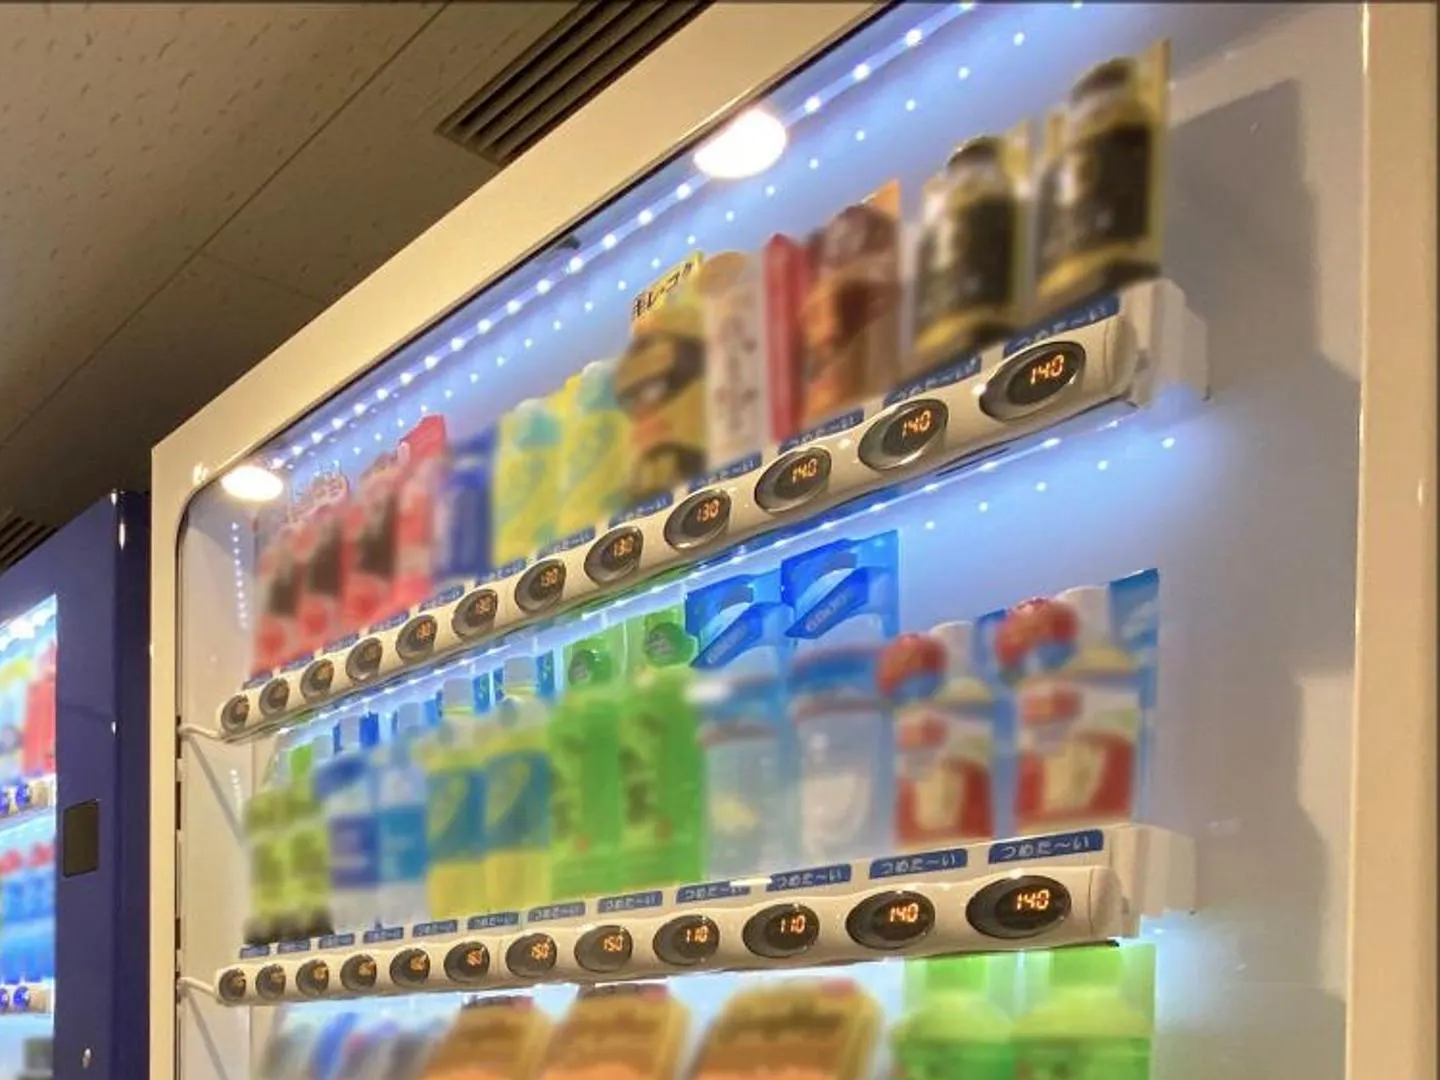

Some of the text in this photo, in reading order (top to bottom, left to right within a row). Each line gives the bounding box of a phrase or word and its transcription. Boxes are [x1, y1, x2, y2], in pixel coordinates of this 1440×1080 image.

[696, 499, 720, 522] 130
[790, 458, 818, 483] 140
[901, 409, 932, 437] 140
[1029, 353, 1065, 385] 140
[686, 925, 709, 943] 110
[780, 915, 806, 934] 110
[889, 902, 919, 923] 140
[1016, 889, 1050, 910] 140
